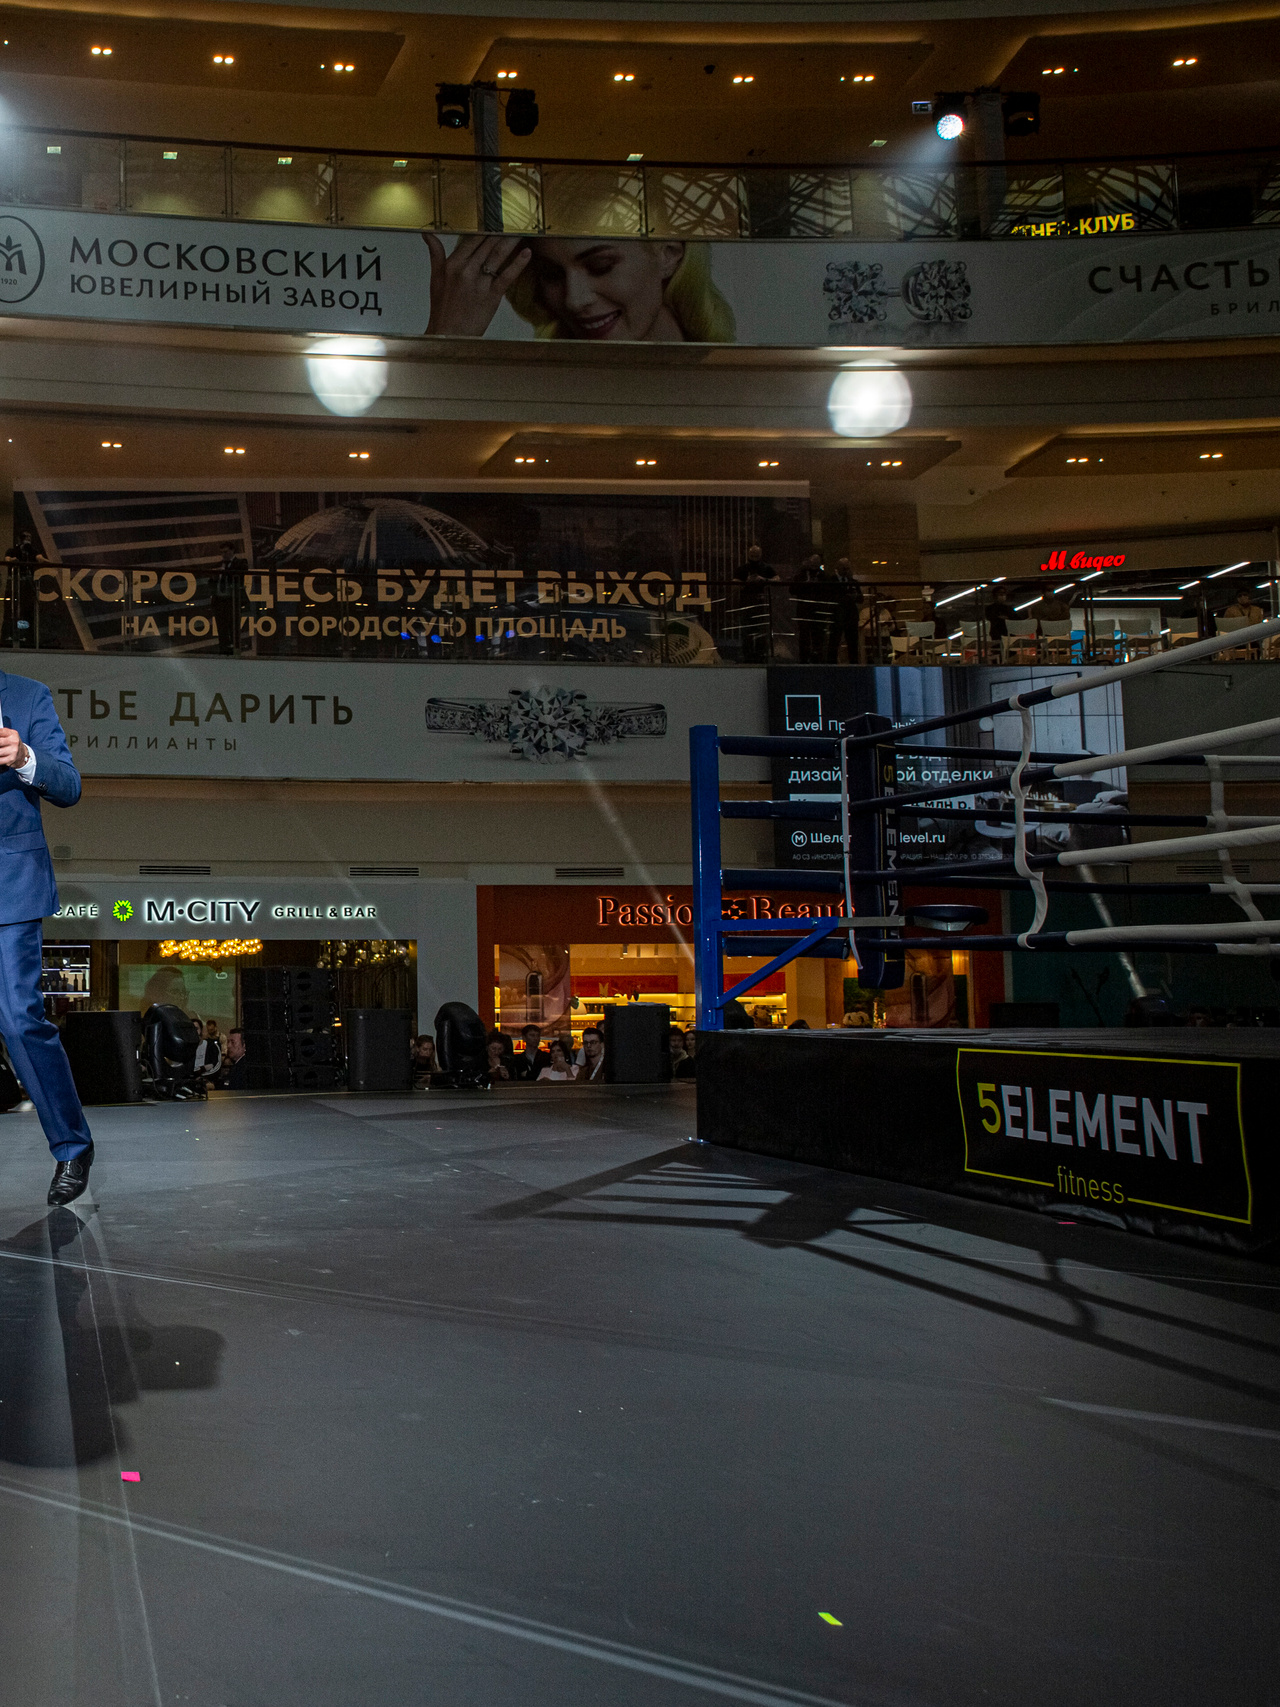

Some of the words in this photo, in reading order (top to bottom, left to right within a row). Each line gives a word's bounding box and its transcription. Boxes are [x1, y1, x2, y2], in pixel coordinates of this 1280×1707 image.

[69, 236, 383, 282] МОСКОВСКИЙ
[0, 277, 18, 286] 1920
[70, 274, 272, 305] ЮВЕЛИРНЫЙ
[282, 287, 383, 316] ЗАВОД
[33, 566, 198, 603] СКОРО
[243, 568, 363, 609] ДЕСЬ
[376, 568, 524, 610] БУДЕТ
[537, 570, 712, 612] ВЫХОД
[121, 615, 161, 637] НА
[284, 615, 467, 641] ГОРОДСКУЮ
[475, 616, 627, 643] ПЛОЩАДЬ
[54, 688, 138, 721] ТЬЕ
[169, 691, 354, 727] ДАРИТЬ
[785, 716, 823, 732] Level
[69, 734, 238, 751] РИЛЛИАНТЫ
[921, 769, 994, 784] отделки
[899, 832, 946, 844] level.ru
[274, 906, 324, 918] GRILL
[329, 907, 338, 918] &
[343, 906, 378, 918] BAR
[596, 895, 694, 926] Passio
[976, 1081, 1209, 1166] 5ELEMENT
[1056, 1165, 1125, 1204] fitness
